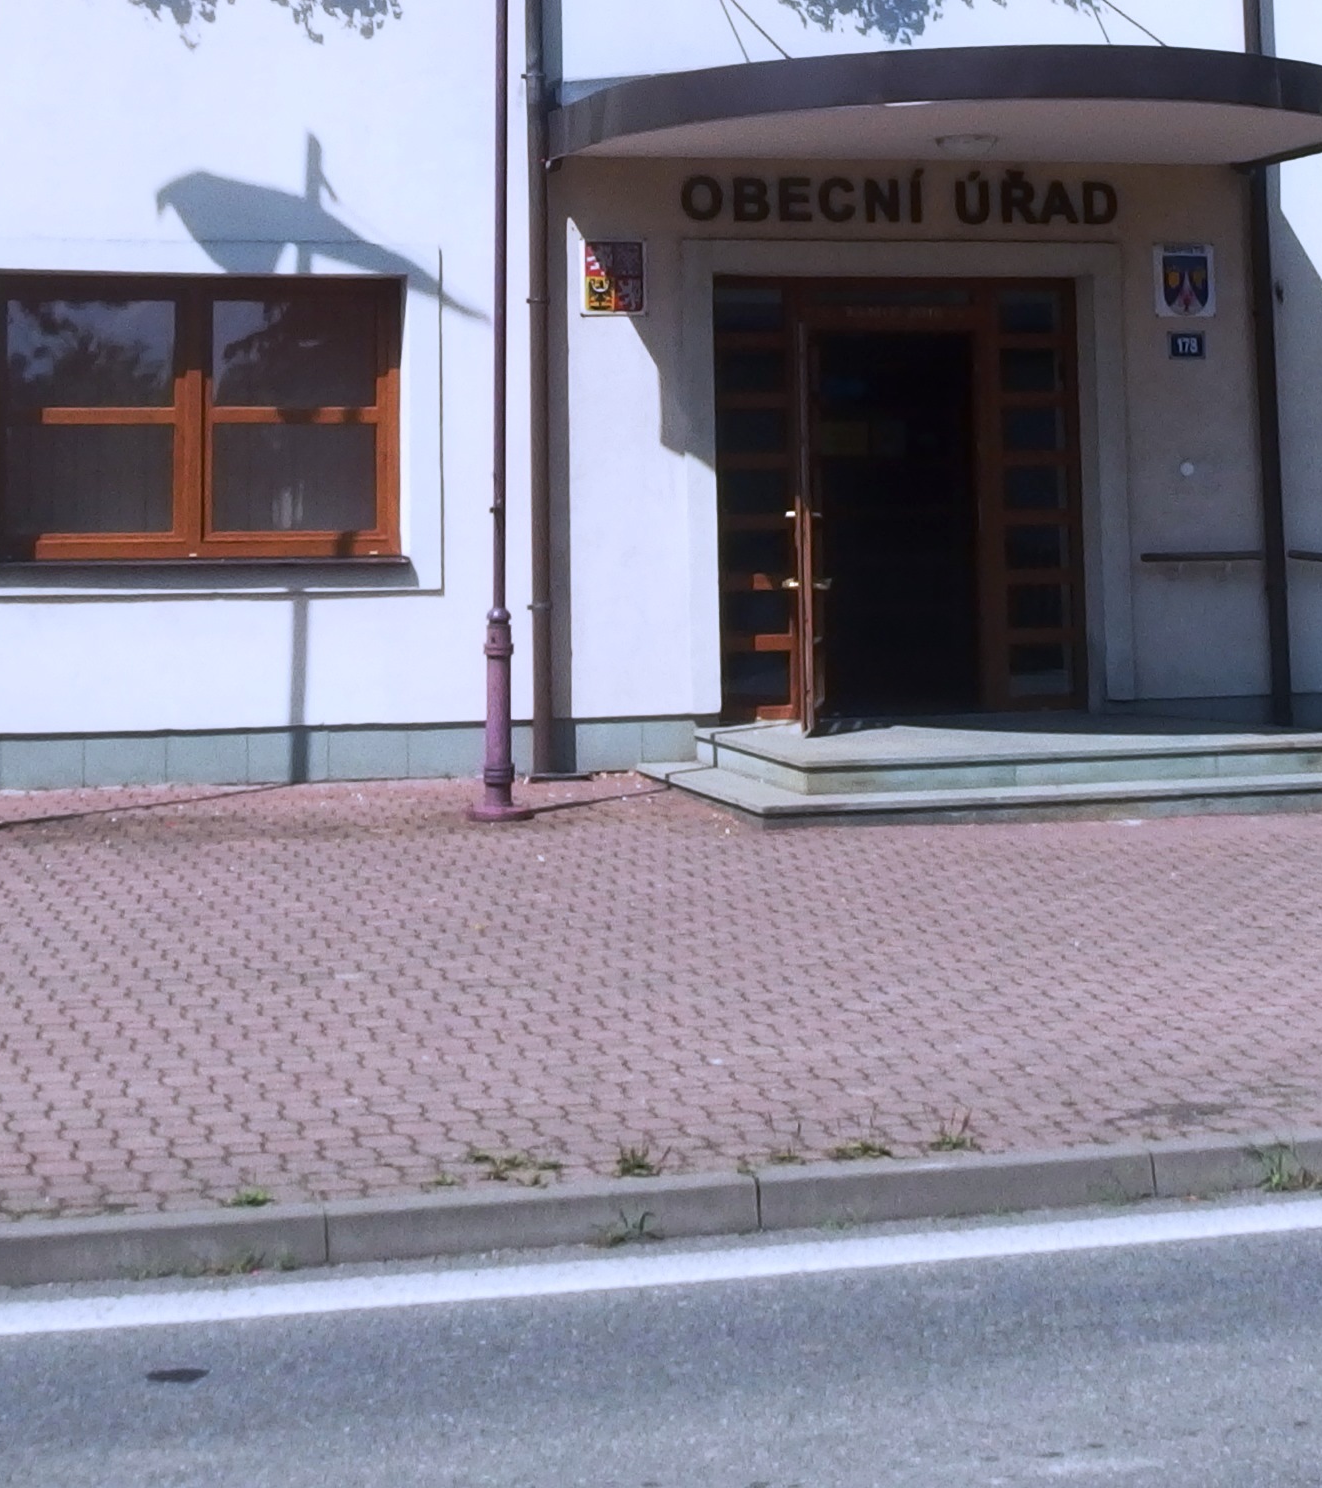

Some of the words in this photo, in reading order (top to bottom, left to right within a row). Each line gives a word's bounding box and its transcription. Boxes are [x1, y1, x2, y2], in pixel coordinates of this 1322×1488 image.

[680, 168, 924, 223] OBECNÍ
[955, 169, 1118, 225] ÚŘAD
[1177, 337, 1198, 354] 178
